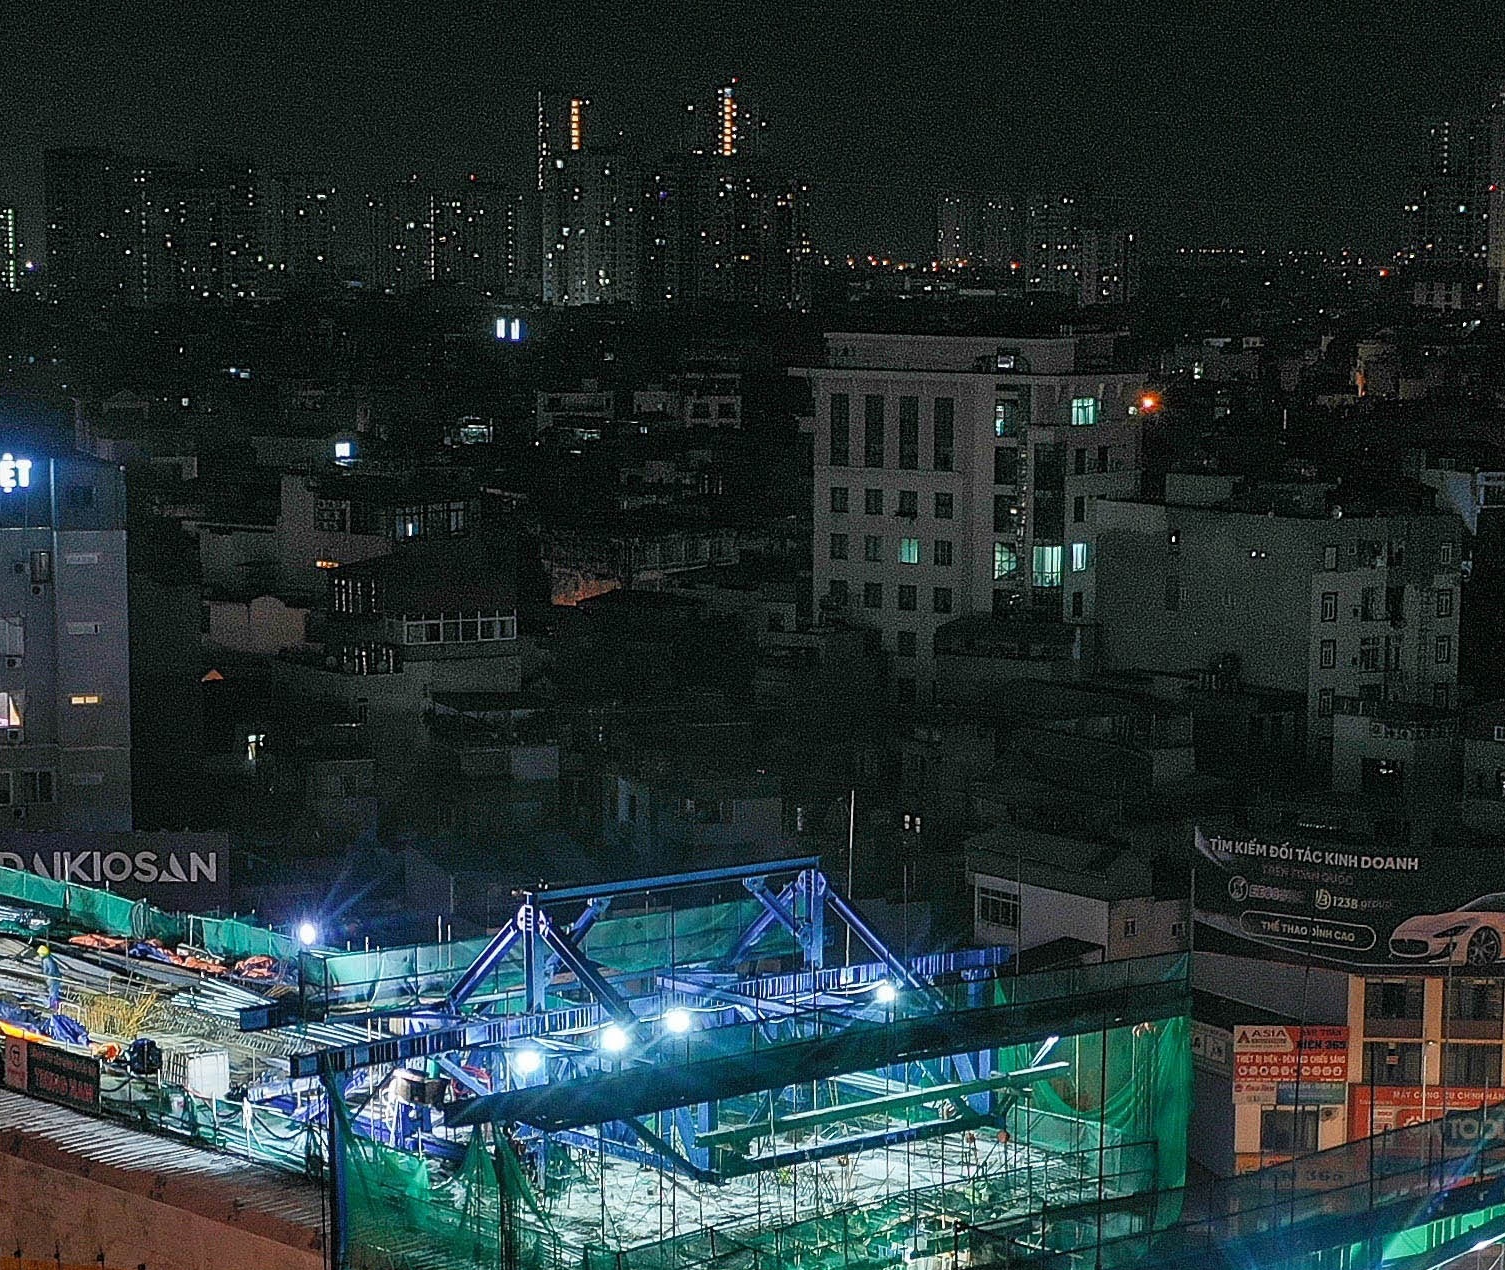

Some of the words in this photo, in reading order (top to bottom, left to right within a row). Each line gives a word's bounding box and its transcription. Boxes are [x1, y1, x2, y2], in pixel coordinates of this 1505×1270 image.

[1209, 835, 1233, 853] TÌM
[1235, 837, 1267, 858] KIẾM
[1268, 841, 1294, 860] ĐỐI
[1295, 846, 1323, 864] TÁC
[1324, 852, 1358, 869] KINH
[1360, 856, 1419, 871] DOANH
[1251, 1029, 1286, 1037] ASIA
